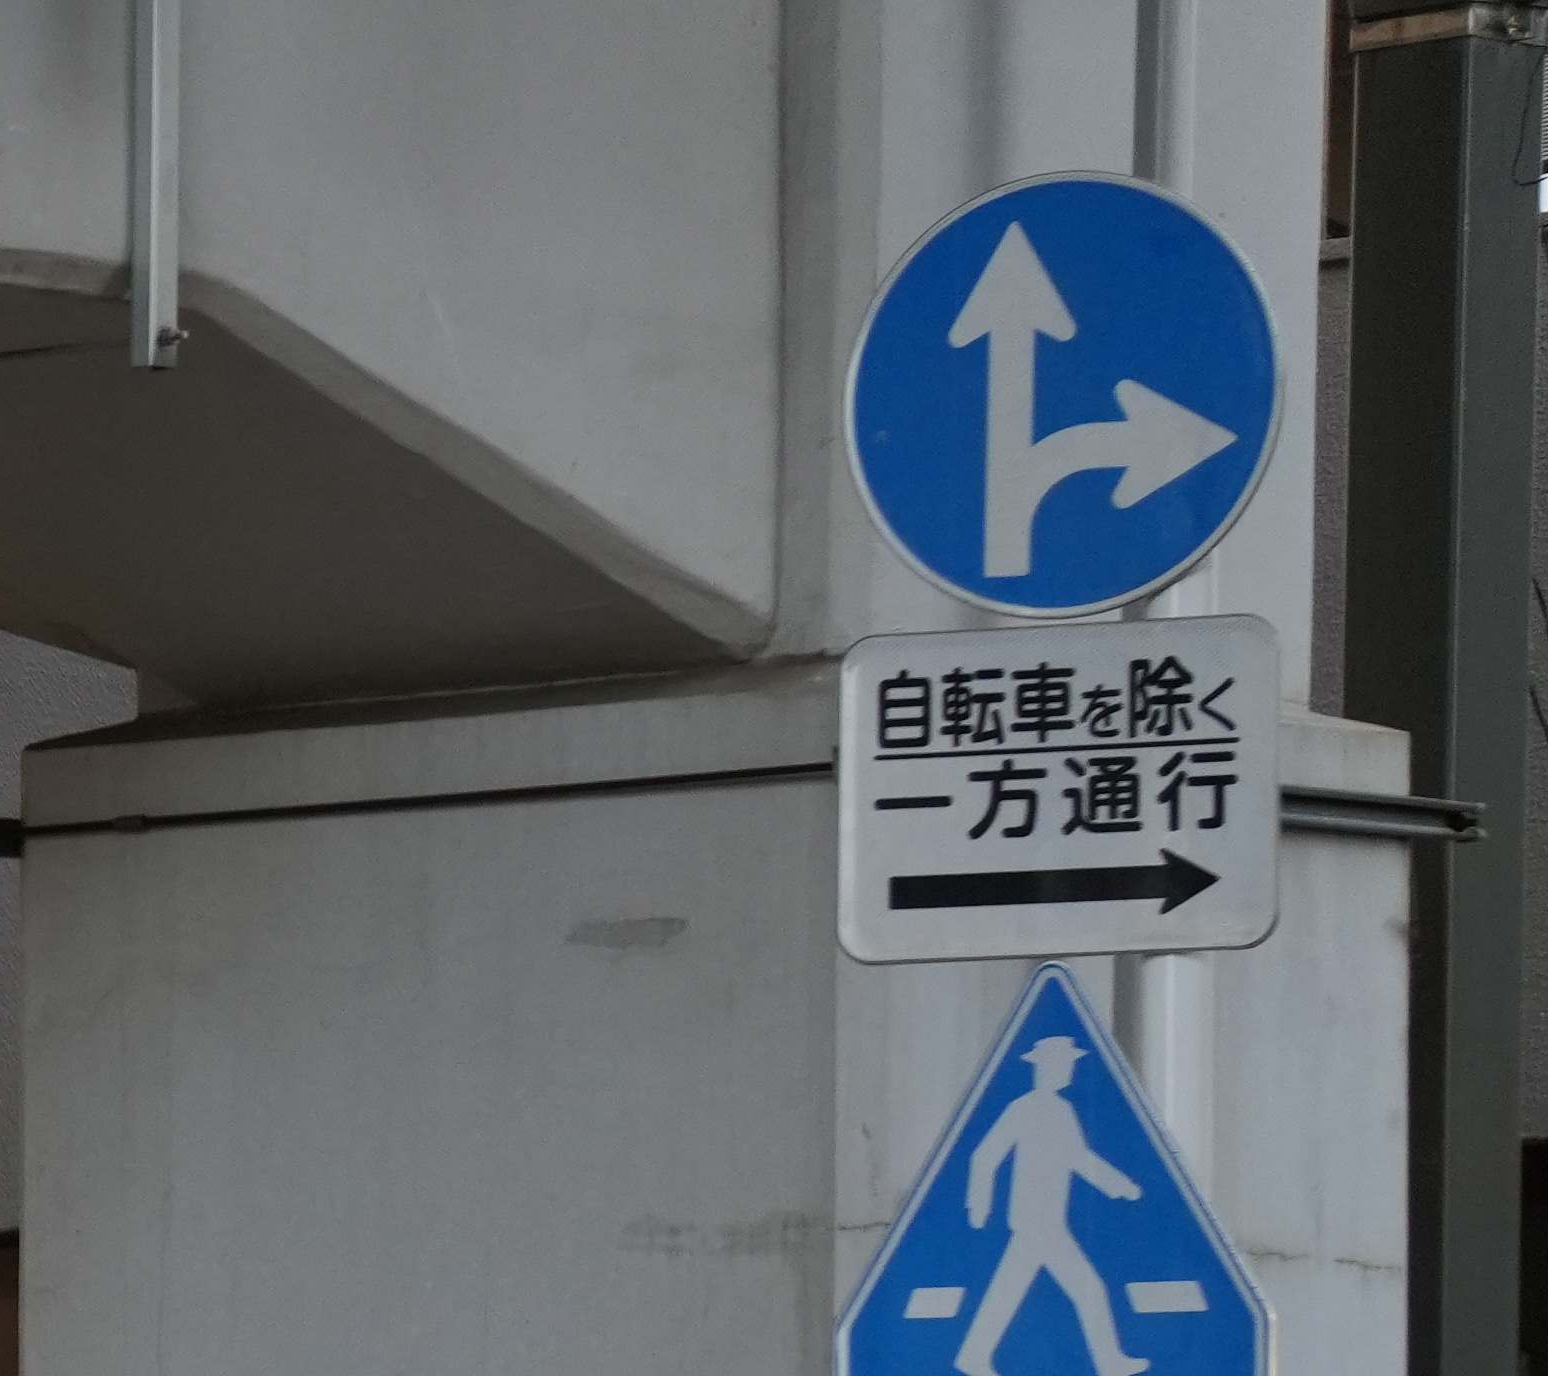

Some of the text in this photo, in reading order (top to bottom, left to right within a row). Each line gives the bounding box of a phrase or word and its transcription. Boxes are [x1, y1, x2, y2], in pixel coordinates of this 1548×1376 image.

[875, 655, 1239, 753] 自転車を除く
[874, 751, 1240, 842] 一方通行
